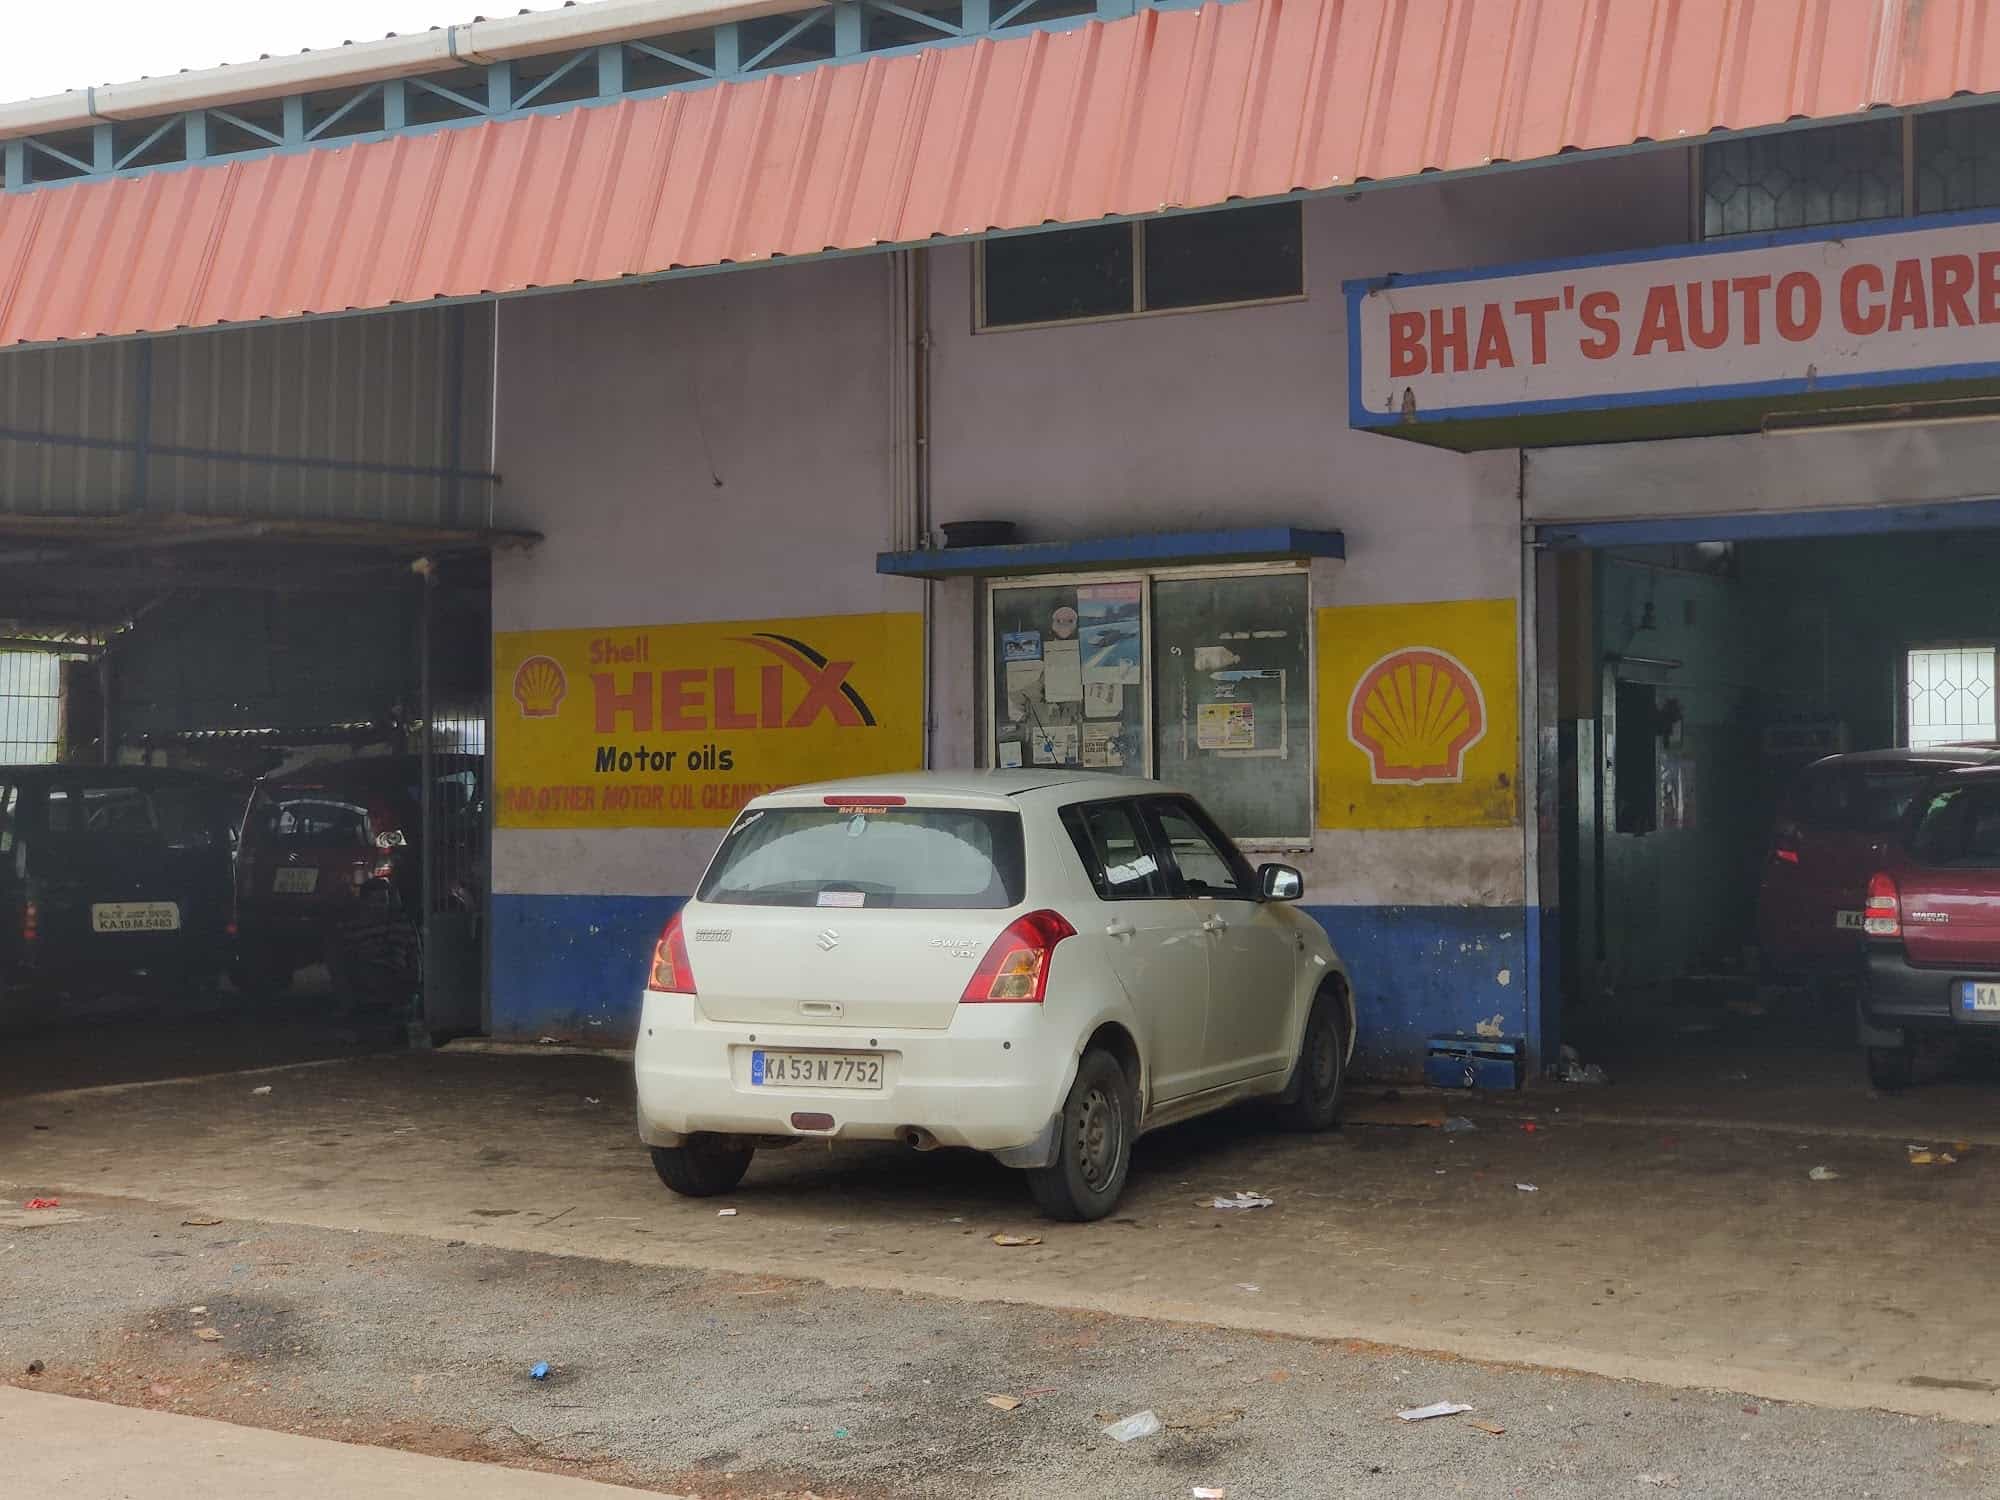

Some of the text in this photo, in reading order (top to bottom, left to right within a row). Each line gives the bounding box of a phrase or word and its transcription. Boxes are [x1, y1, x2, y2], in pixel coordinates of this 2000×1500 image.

[1389, 251, 2000, 378] BHAT'S AUTO CARE
[589, 635, 649, 665] Shell
[591, 660, 860, 734] HELIX
[595, 744, 734, 773] Motor oils
[602, 785, 664, 811] MOTOR
[670, 784, 697, 810] OIL
[765, 1058, 879, 1083] KA 53 N 7752
